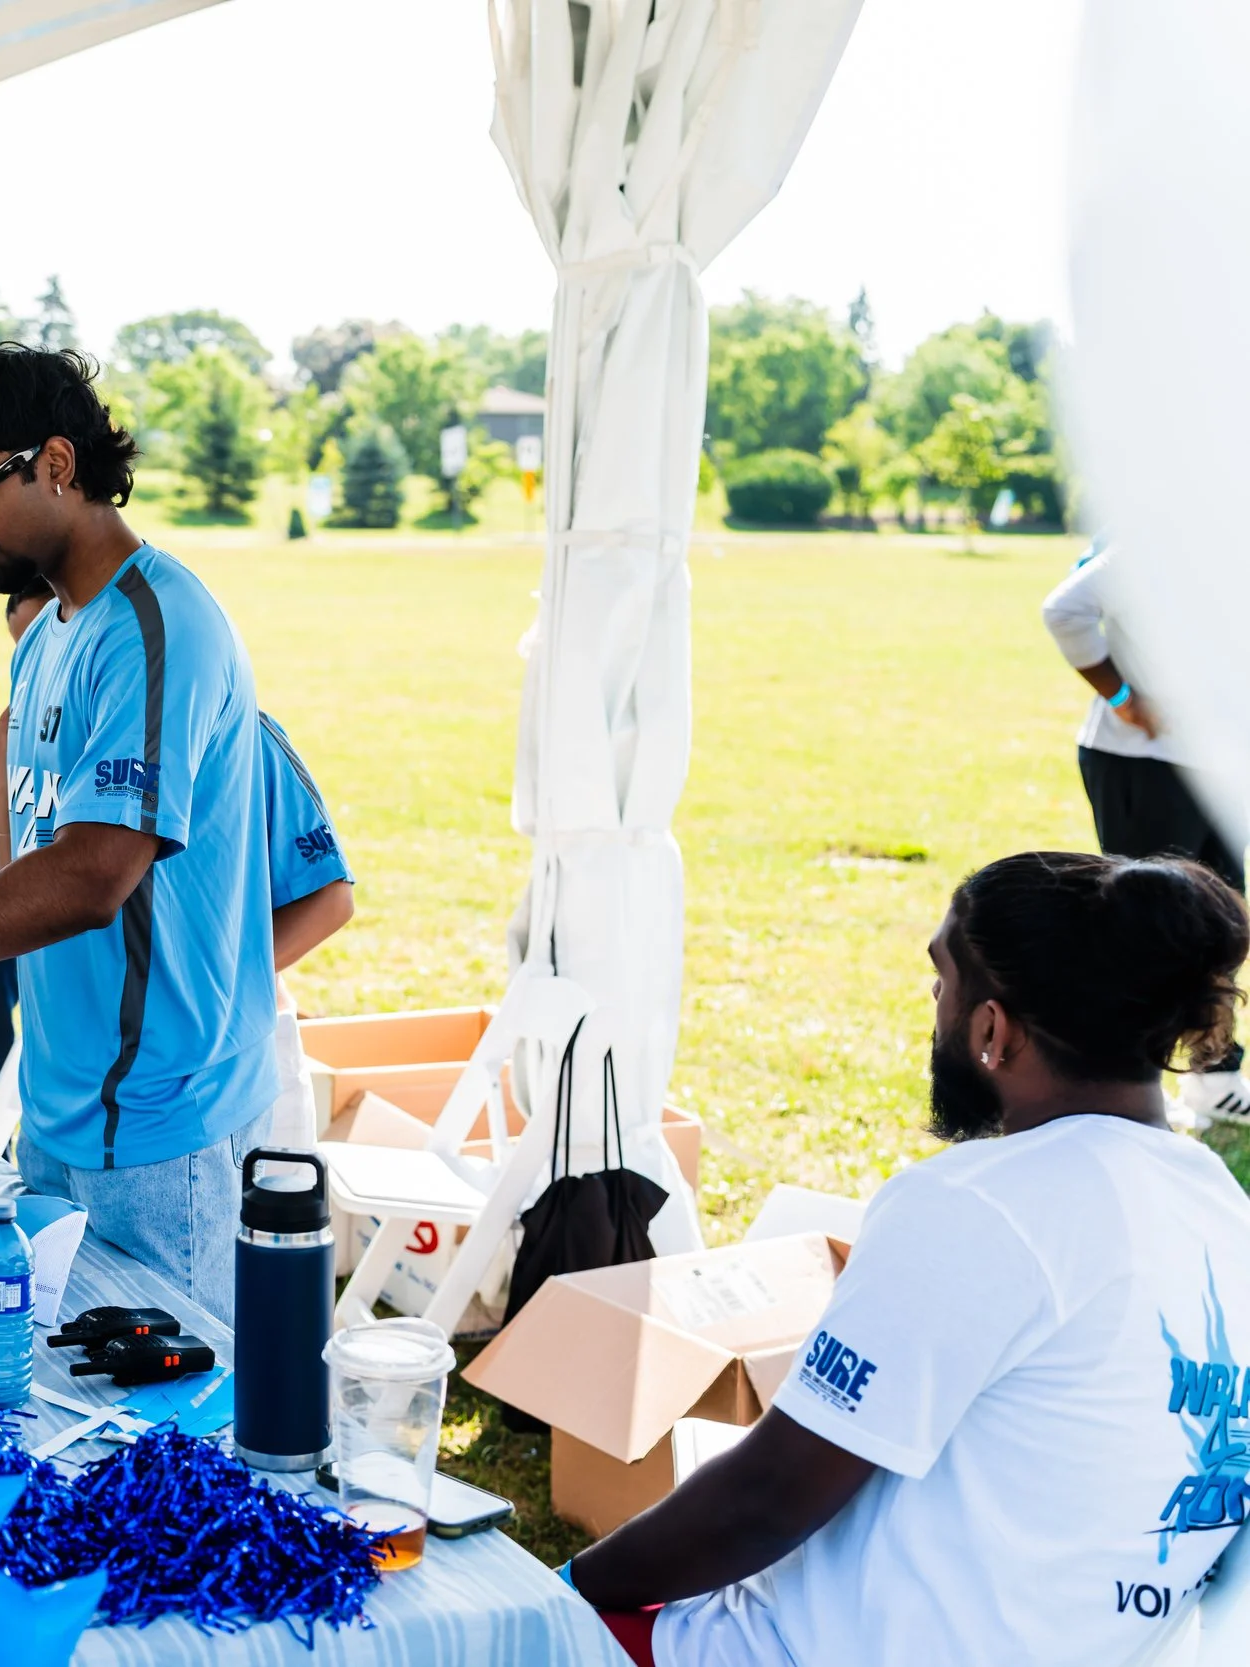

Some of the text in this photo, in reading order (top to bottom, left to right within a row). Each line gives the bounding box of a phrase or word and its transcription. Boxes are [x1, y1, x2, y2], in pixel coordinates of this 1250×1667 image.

[94, 757, 161, 793] SURE
[295, 824, 336, 859] SUR
[805, 1330, 878, 1403] SURE
